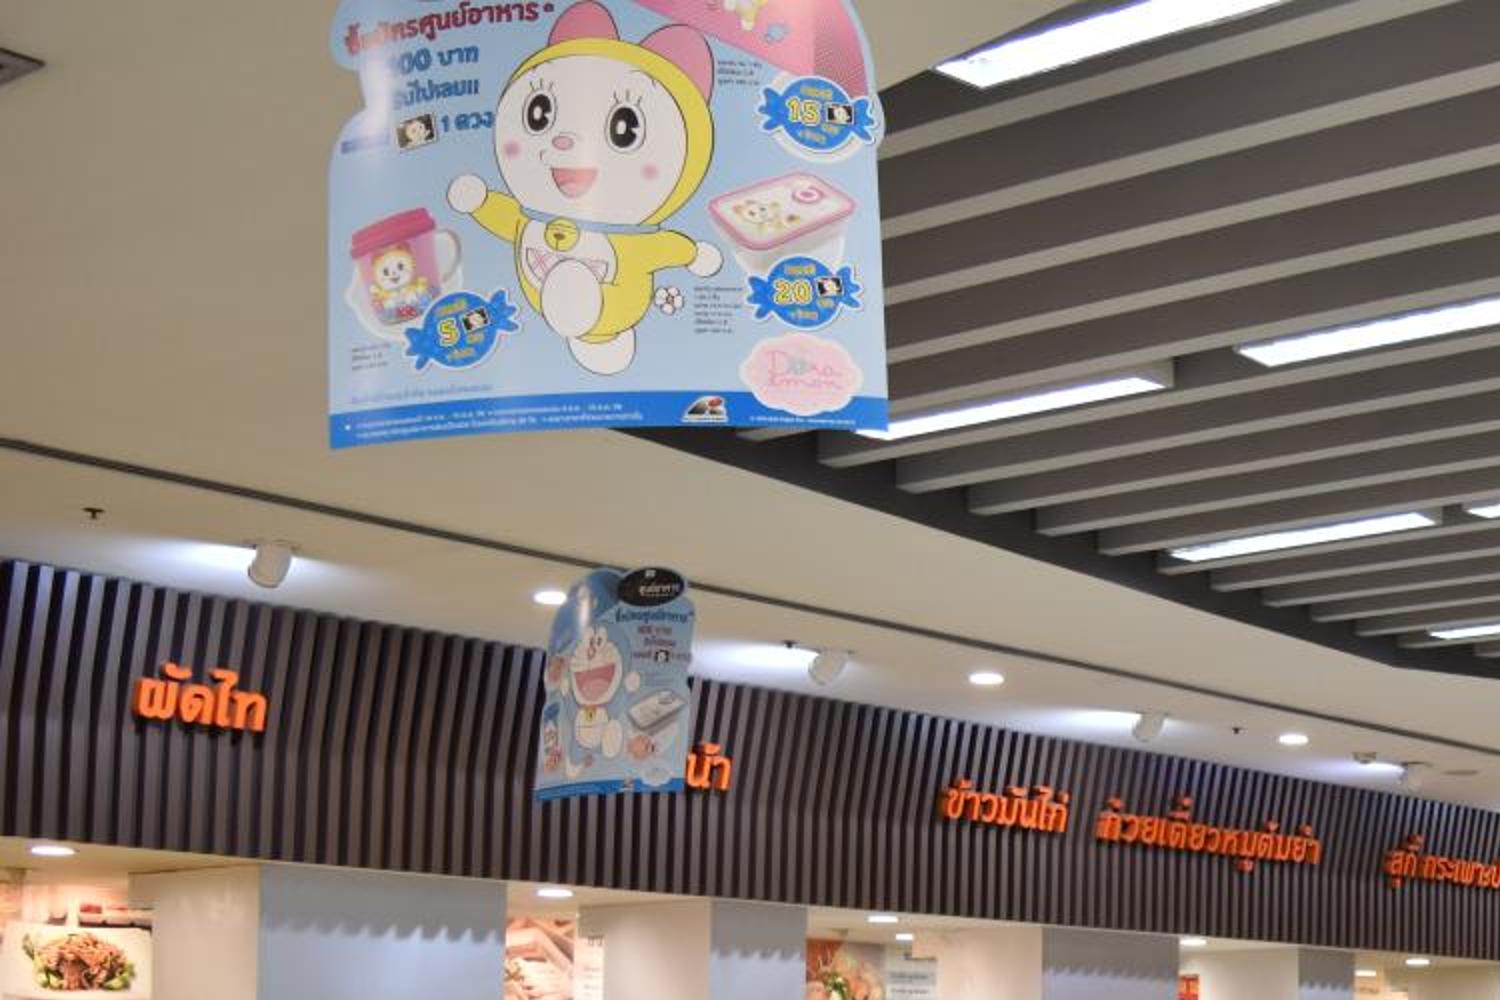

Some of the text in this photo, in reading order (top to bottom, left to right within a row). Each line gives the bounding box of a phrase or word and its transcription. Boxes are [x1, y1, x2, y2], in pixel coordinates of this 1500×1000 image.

[786, 96, 821, 126] 15
[773, 279, 813, 305] 20
[437, 317, 459, 346] 5
[944, 778, 1068, 832] ข้าวมันไก่
